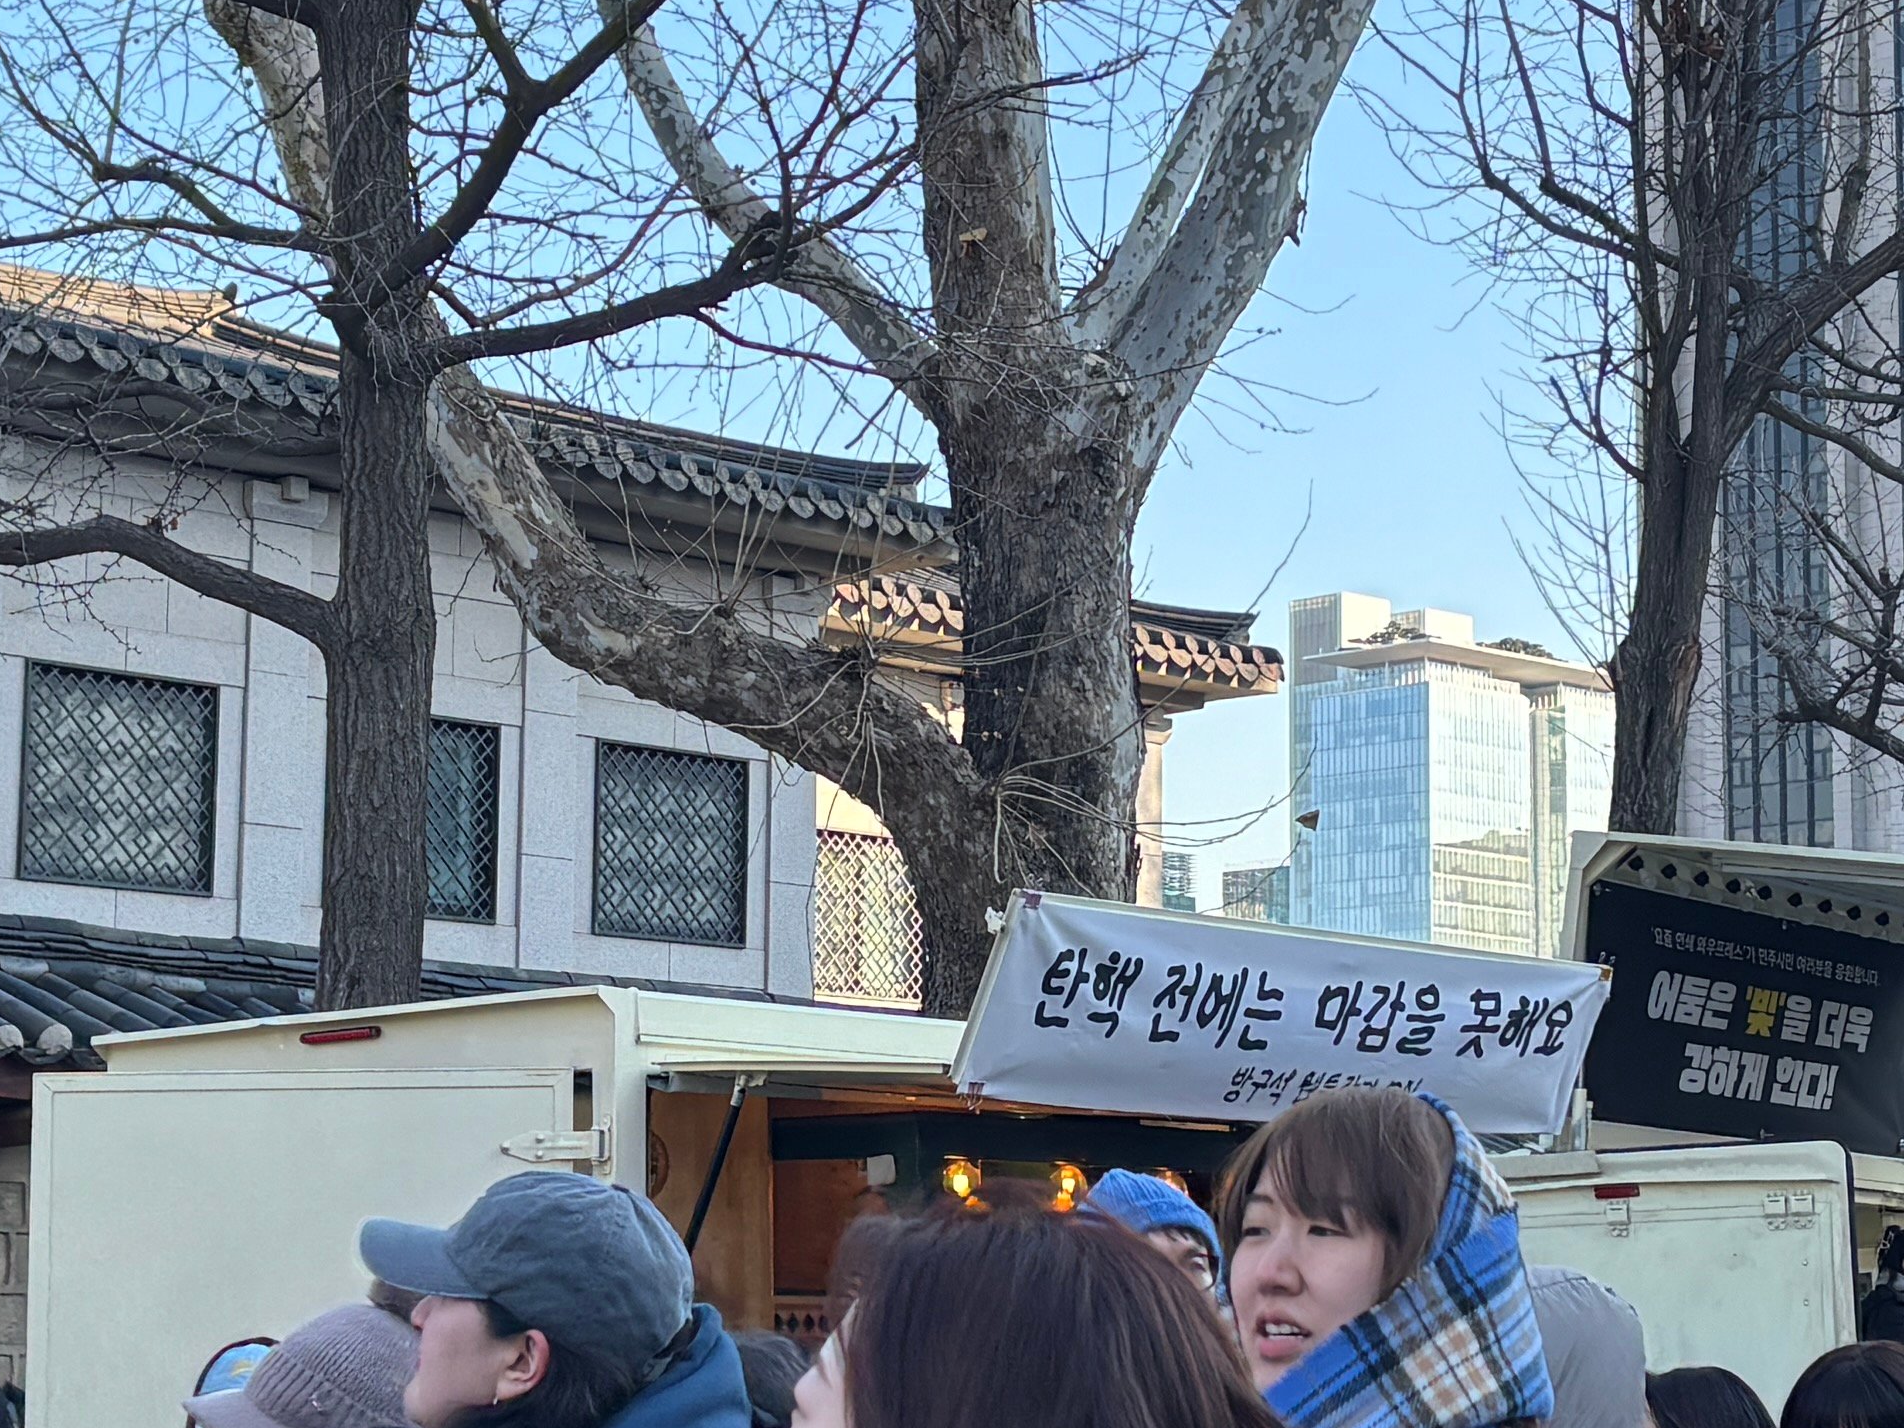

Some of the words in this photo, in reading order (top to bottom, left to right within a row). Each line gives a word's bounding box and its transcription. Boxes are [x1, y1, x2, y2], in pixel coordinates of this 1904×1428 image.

[1758, 950, 1794, 971] 민주시민
[1033, 947, 1144, 1039] 탄핵
[1148, 962, 1284, 1051] 전에는
[1314, 980, 1446, 1057] 마감을
[1455, 988, 1574, 1058] 못해요
[1647, 970, 1737, 1030] 어둠은
[1815, 999, 1874, 1053] 더욱
[1223, 1066, 1297, 1106] 방구석
[1678, 1042, 1770, 1101] 강하게
[1770, 1056, 1839, 1111] 한다!
